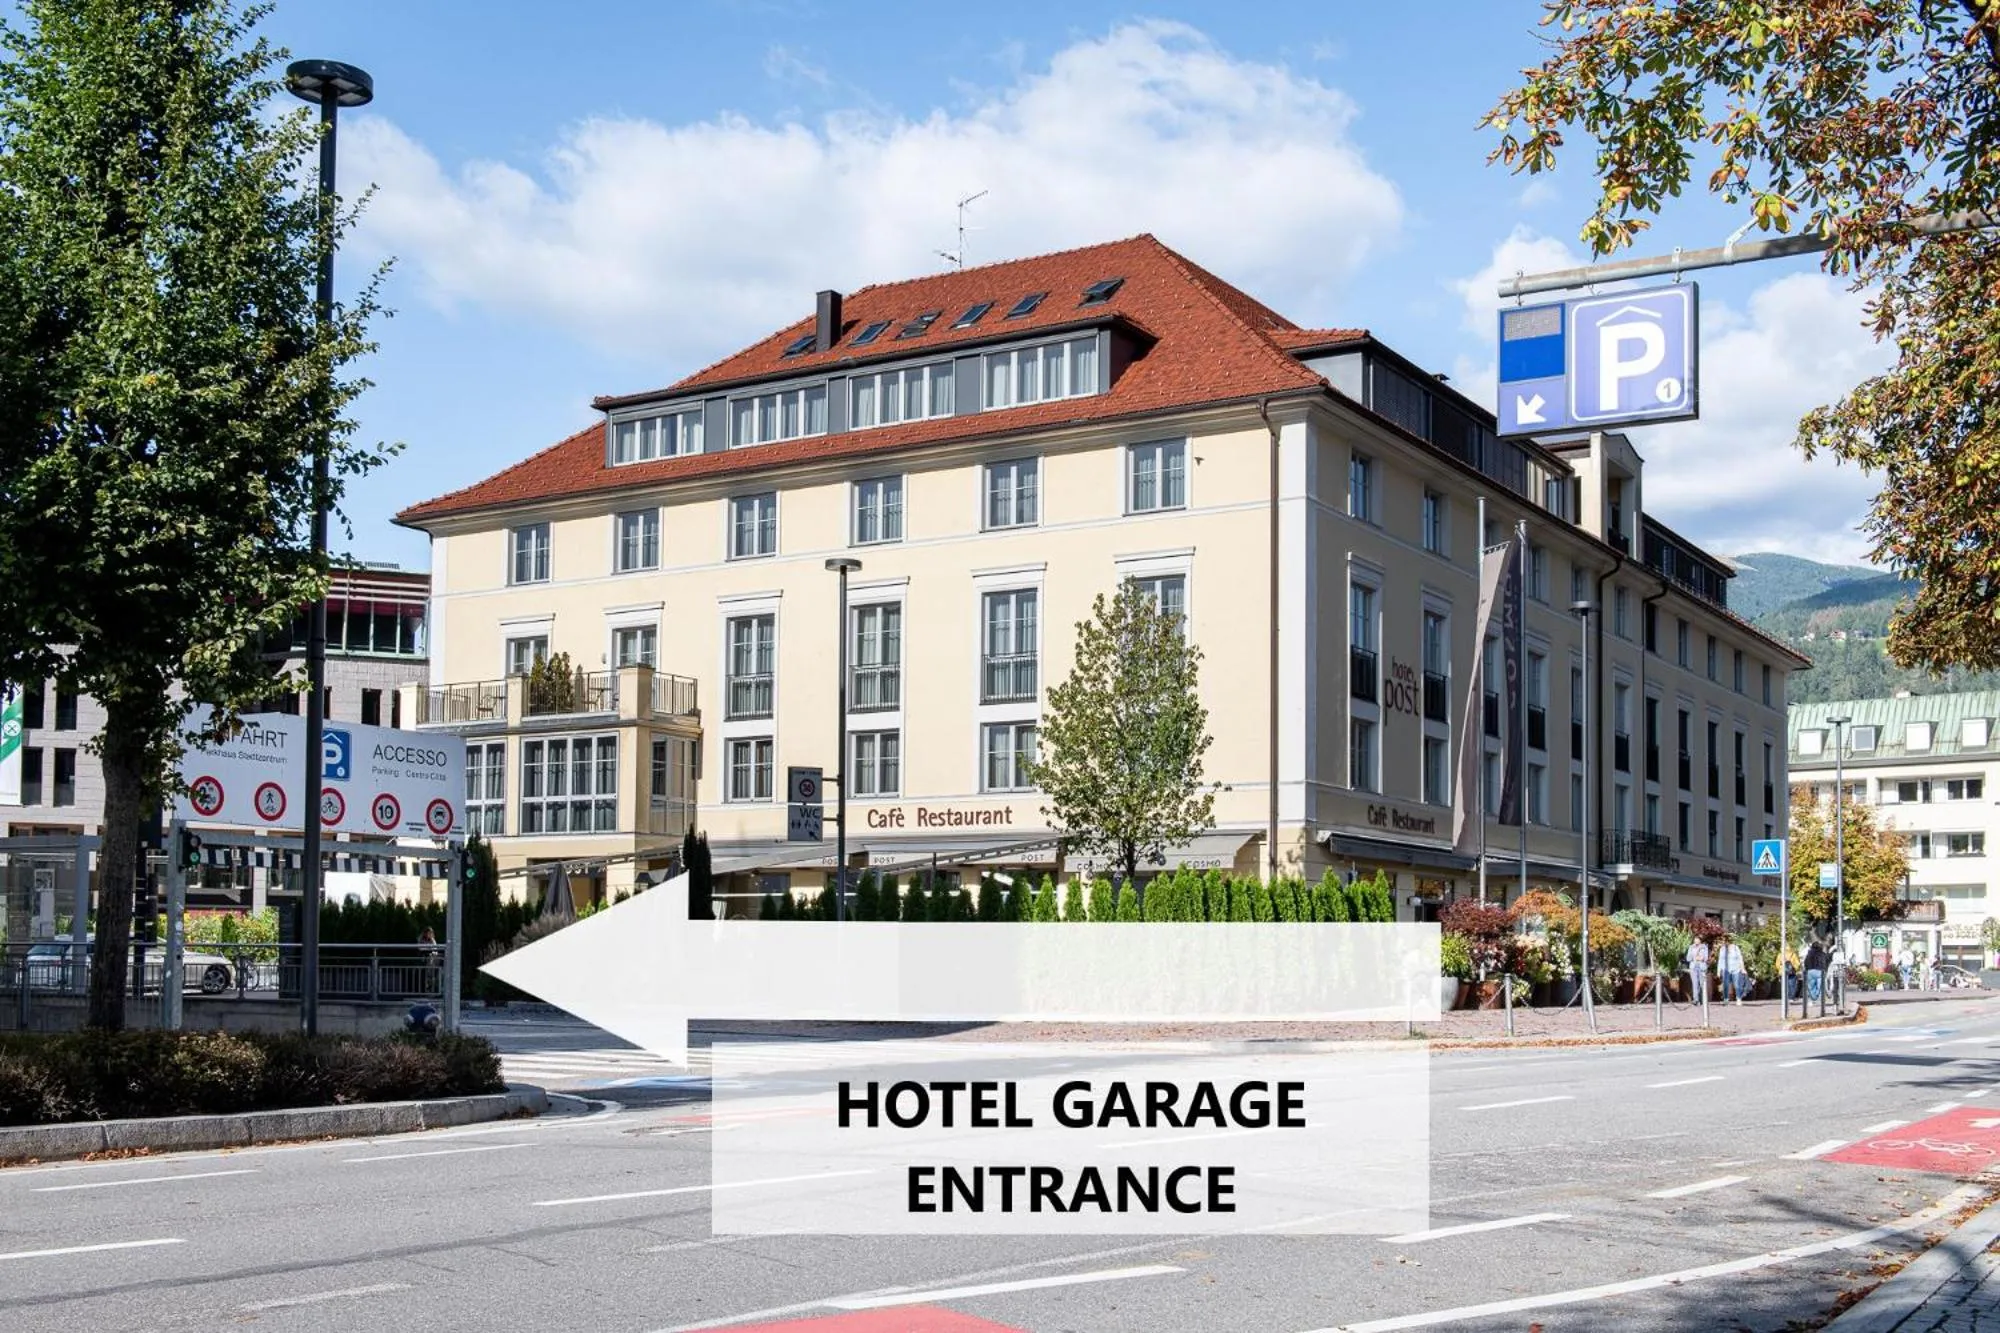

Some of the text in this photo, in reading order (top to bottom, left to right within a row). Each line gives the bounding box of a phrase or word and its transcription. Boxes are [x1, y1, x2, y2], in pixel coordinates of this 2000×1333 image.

[1600, 321, 1665, 411] P
[1663, 381, 1672, 399] 1
[1391, 656, 1414, 682] hotel
[1384, 678, 1419, 726] post
[201, 722, 287, 748] EAHRT
[202, 748, 237, 759] arkhaus
[322, 742, 343, 775] P
[373, 744, 447, 767] ACCESSO
[372, 766, 400, 778] Parking
[378, 805, 394, 820] 10
[800, 808, 821, 818] WC
[867, 806, 1013, 829] Cafè Restaurant
[1392, 808, 1436, 834] Restaurant
[822, 857, 839, 866] POS
[874, 856, 896, 865] POST
[1021, 853, 1045, 863] POST
